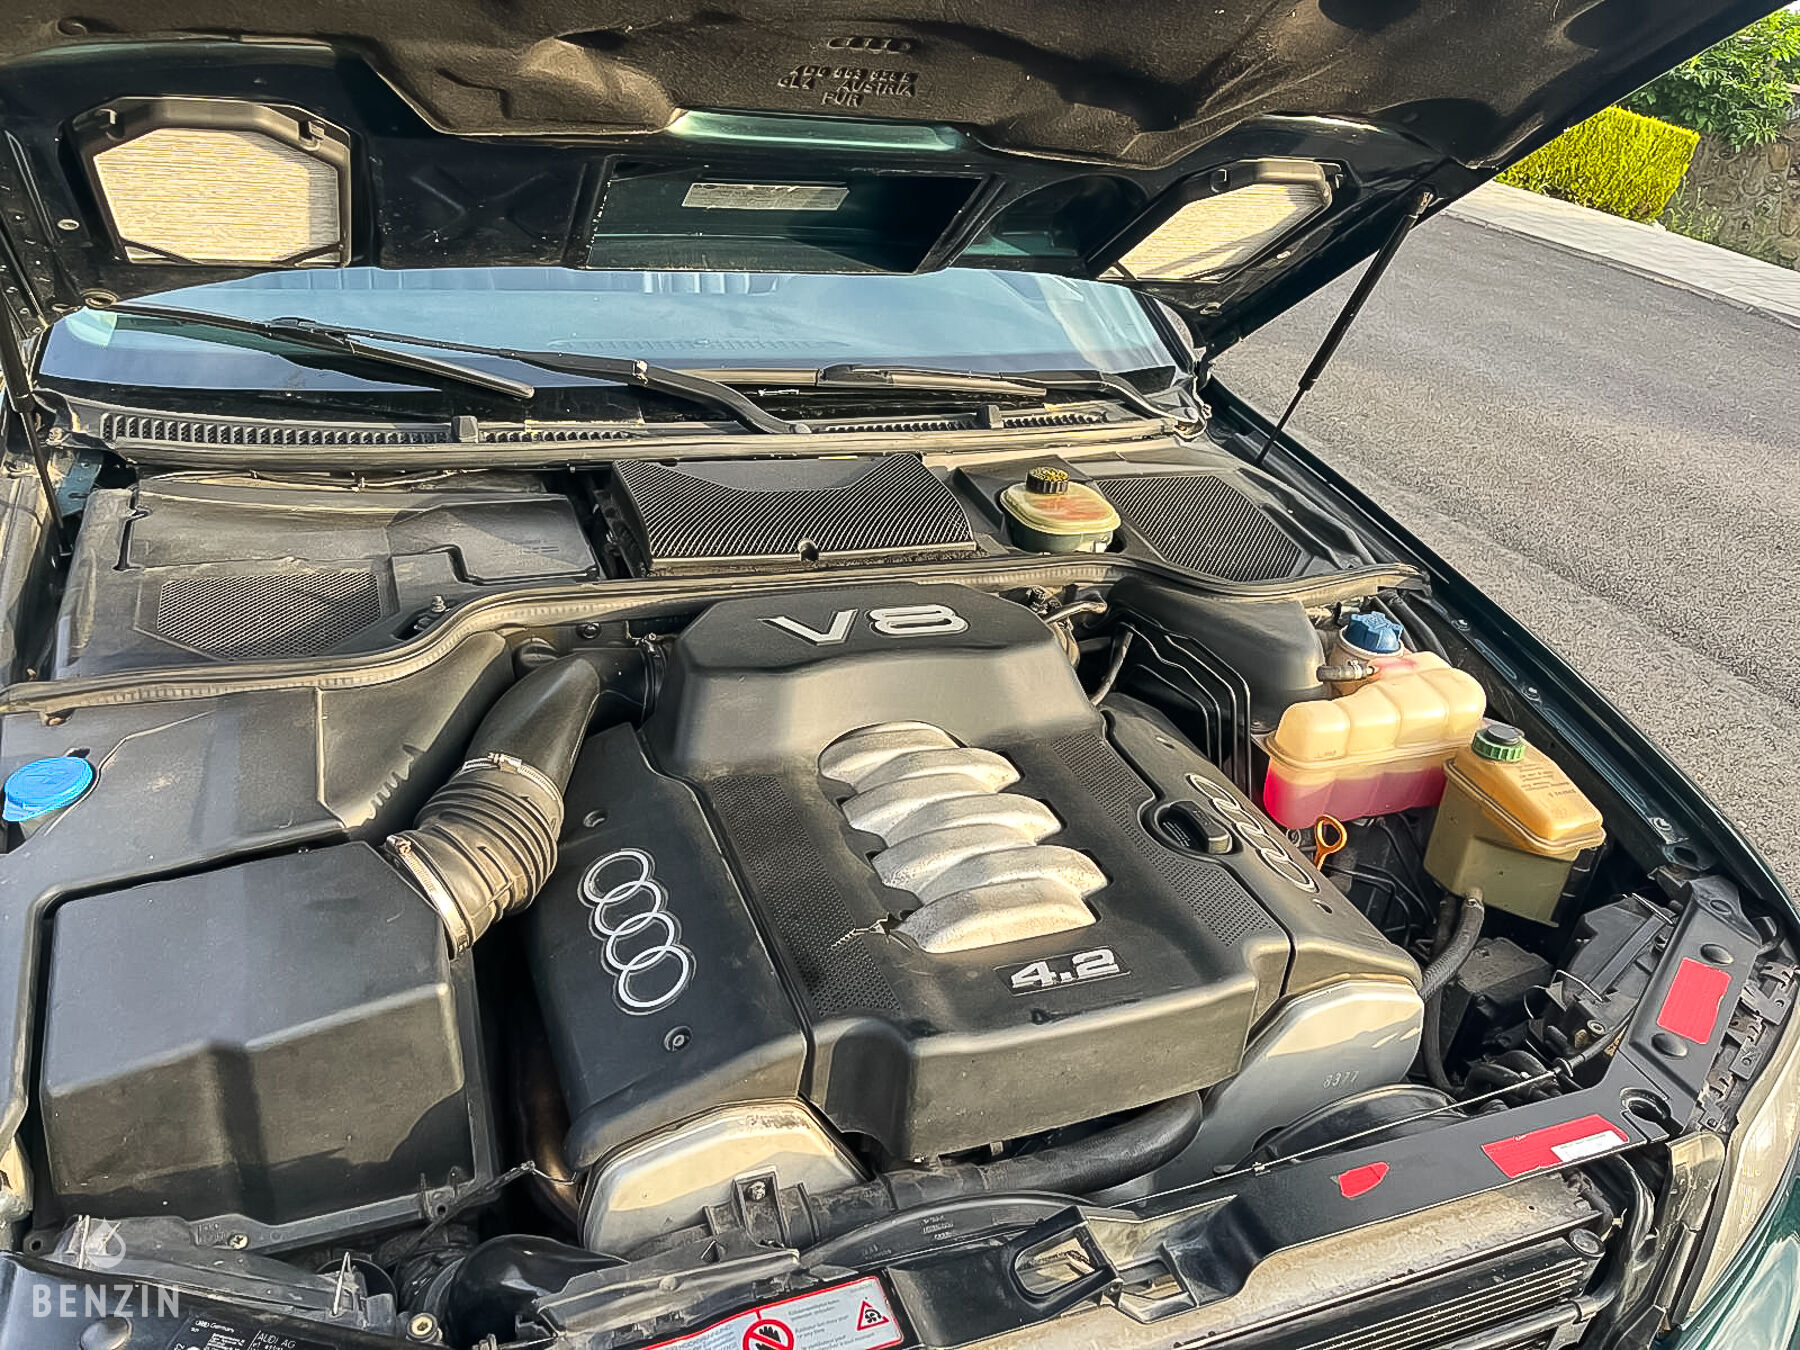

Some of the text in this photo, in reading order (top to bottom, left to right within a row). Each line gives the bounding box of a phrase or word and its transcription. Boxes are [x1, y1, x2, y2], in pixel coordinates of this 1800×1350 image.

[836, 79, 916, 98] AUSTRIA
[756, 603, 971, 647] V8
[1010, 949, 1120, 989] 4.2
[257, 1332, 279, 1345] AUDI
